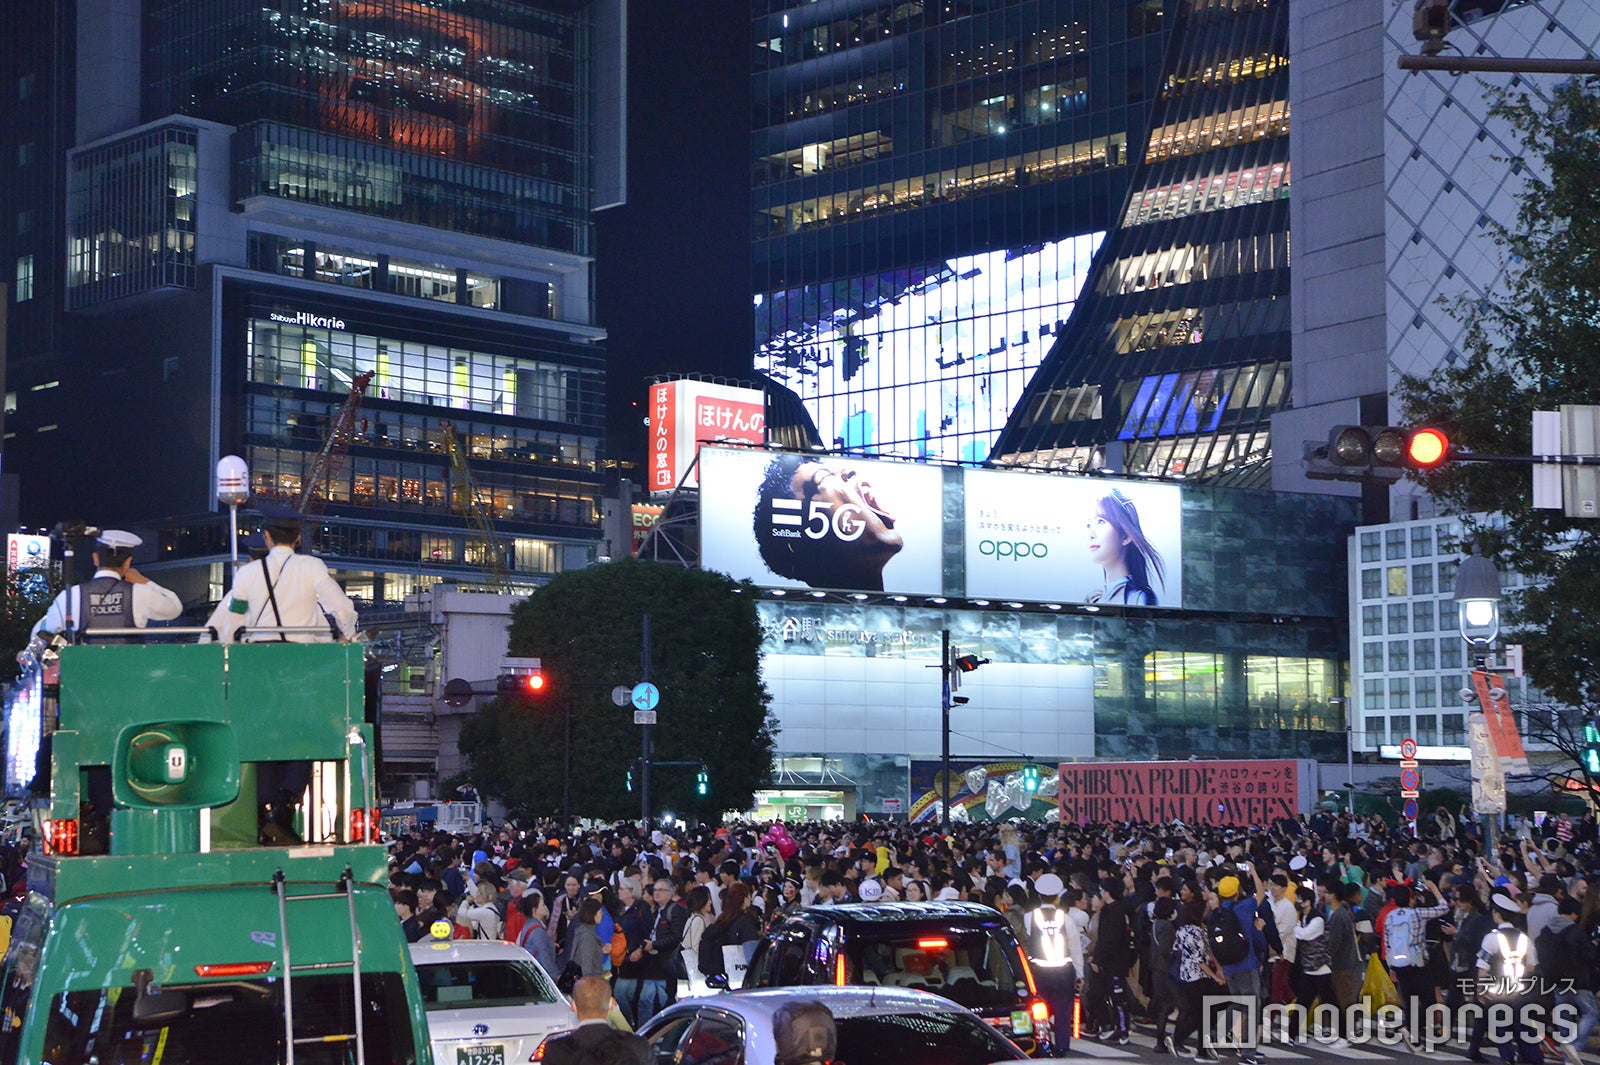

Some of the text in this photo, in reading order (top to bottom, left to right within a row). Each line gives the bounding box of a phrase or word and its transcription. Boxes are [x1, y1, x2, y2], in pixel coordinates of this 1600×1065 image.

[296, 311, 346, 330] Hikarie
[697, 403, 765, 434] ほけんの
[804, 500, 867, 542] 5G
[771, 528, 802, 539] SoftBank
[979, 539, 1048, 562] oppo
[90, 605, 123, 615] POLICE
[1062, 768, 1217, 795] SHIBUYA PRIDE
[1219, 767, 1293, 778] ハロウィーンを
[1219, 781, 1293, 795] 渋谷の誇りに
[1062, 797, 1294, 825] SHIBUYA HALLOWEEN
